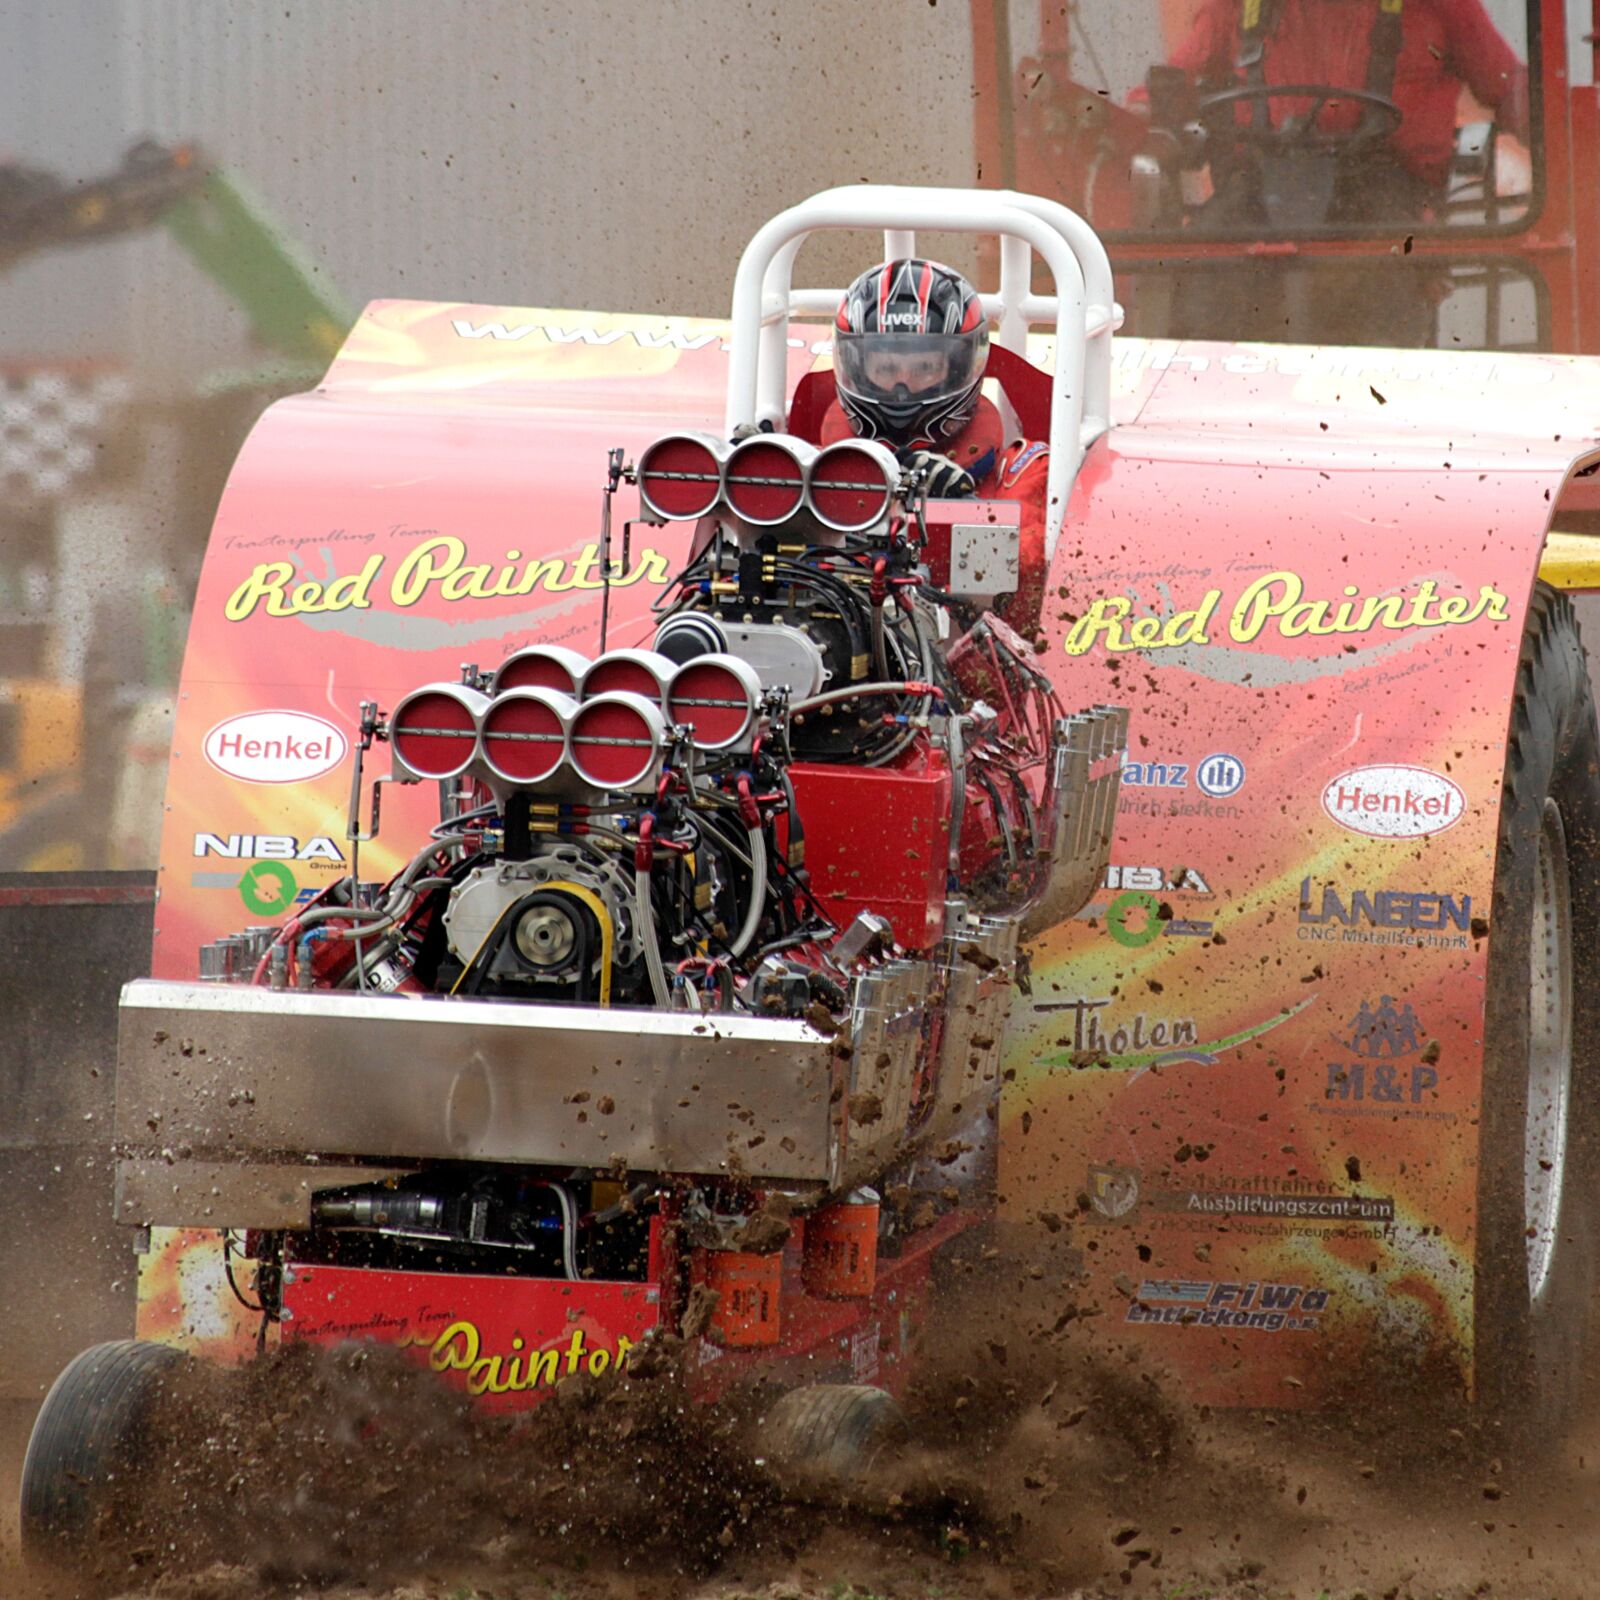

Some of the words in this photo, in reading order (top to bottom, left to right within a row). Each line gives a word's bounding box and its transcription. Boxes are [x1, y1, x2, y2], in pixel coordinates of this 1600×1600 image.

[881, 312, 923, 326] uvex
[224, 554, 384, 621] Red
[390, 536, 669, 607] Painter
[1063, 588, 1222, 657] Red
[1228, 570, 1509, 643] Painter
[218, 733, 333, 760] Henkel
[1121, 761, 1190, 787] anz
[1336, 786, 1452, 816] Henkel
[192, 832, 347, 861] NIBA
[309, 862, 348, 871] GmbH
[1102, 865, 1214, 893] IBA
[1298, 874, 1472, 931] LANGEN
[1296, 926, 1337, 941] CNC
[1033, 999, 1198, 1055] Tholen
[1208, 1281, 1329, 1311] Fiwa
